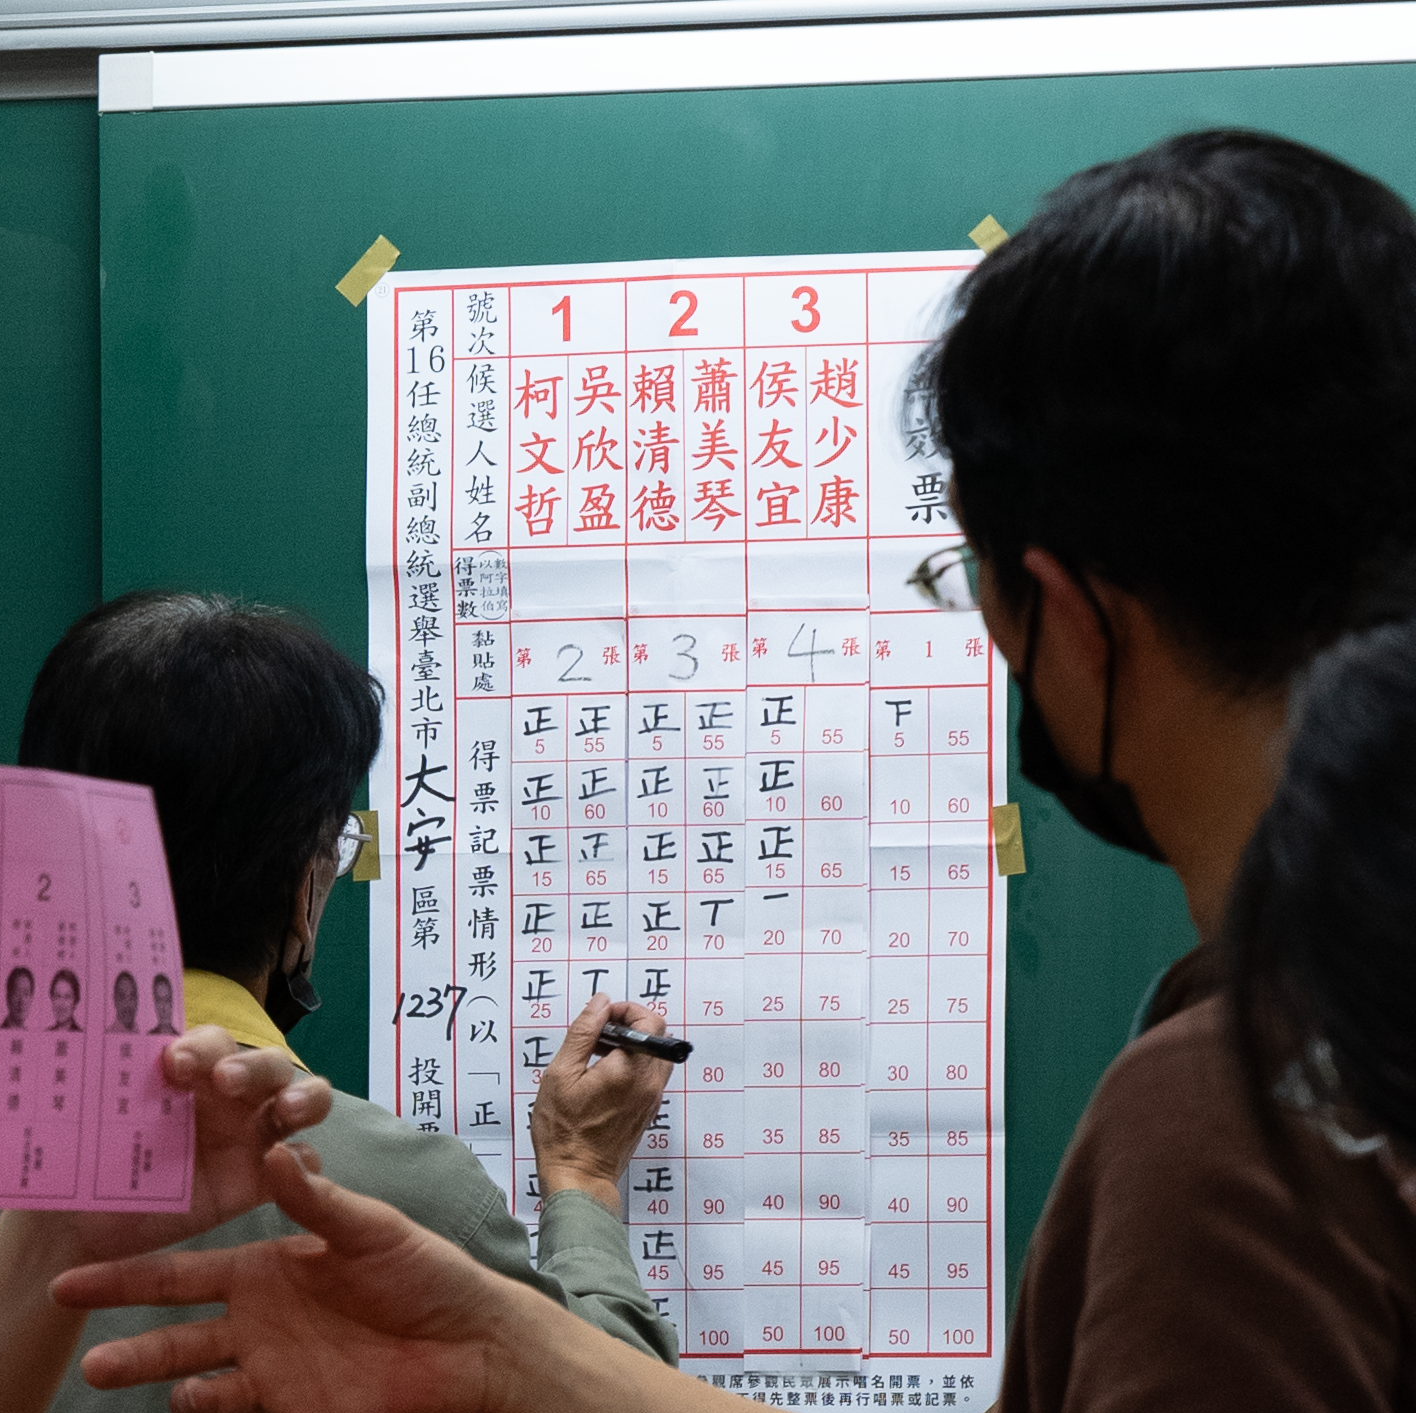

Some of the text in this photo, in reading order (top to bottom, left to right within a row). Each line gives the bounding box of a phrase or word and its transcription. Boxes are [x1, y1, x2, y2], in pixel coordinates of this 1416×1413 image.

[668, 290, 699, 337] 2
[791, 286, 821, 333] 3
[466, 292, 497, 355] 號次
[551, 295, 571, 341] 1
[571, 365, 623, 532] 吳欣盈
[630, 364, 680, 532] 賴清德
[691, 357, 742, 532] 蕭美琴
[750, 361, 803, 528] 侯友宜
[810, 357, 863, 528] 趙少康
[465, 364, 497, 544] 候選人姓名
[514, 368, 564, 537] 柯文哲
[455, 557, 478, 619] 得票數
[634, 634, 740, 680] 第 3 張
[753, 623, 860, 686] 第 4 張
[876, 638, 983, 660] 第 1 張
[471, 630, 496, 692] 黏貼處
[517, 644, 620, 682] 第 2 張
[638, 704, 681, 734] 正
[697, 702, 733, 730] 正
[761, 696, 796, 726] 正
[523, 707, 557, 736] 正
[575, 706, 610, 739] 正
[653, 736, 662, 751] 5
[703, 735, 724, 750] 55
[771, 730, 781, 745] 5
[822, 729, 843, 744] 55
[895, 732, 904, 747] 5
[948, 730, 969, 746] 55
[535, 739, 545, 754] 5
[584, 737, 605, 753] 55
[578, 768, 616, 800] 正
[637, 766, 672, 798] 正
[703, 768, 731, 800] 正
[759, 760, 794, 792] 正
[522, 774, 562, 808] 正
[585, 804, 605, 819] 60
[648, 802, 668, 818] 10
[703, 801, 724, 817] 60
[767, 796, 786, 812] 10
[821, 796, 842, 811] 60
[891, 799, 910, 814] 10
[948, 798, 969, 813] 60
[532, 805, 551, 820] 10
[524, 835, 556, 865] 正
[581, 833, 608, 860] 正
[644, 832, 676, 861] 正
[697, 831, 733, 863] 正
[758, 826, 793, 860] 正
[533, 871, 552, 886] 15
[586, 870, 606, 886] 65
[649, 869, 668, 884] 15
[703, 868, 724, 884] 65
[766, 863, 785, 878] 15
[821, 863, 842, 878] 65
[891, 865, 910, 881] 15
[948, 864, 969, 880] 65
[37, 873, 51, 902] 2
[129, 881, 141, 909] 3
[522, 903, 554, 934] 正
[581, 902, 612, 929] 正
[643, 901, 680, 932] 正
[532, 937, 552, 952] 20
[587, 936, 607, 951] 70
[647, 935, 668, 950] 20
[703, 934, 724, 950] 70
[764, 930, 784, 945] 20
[821, 929, 841, 944] 70
[889, 932, 910, 948] 20
[948, 931, 969, 946] 70
[522, 970, 555, 1001] 正
[640, 969, 671, 1001] 正
[530, 1003, 551, 1018] 25
[703, 1001, 723, 1016] 75
[763, 996, 784, 1011] 25
[820, 996, 840, 1011] 75
[888, 999, 909, 1014] 25
[947, 998, 968, 1013] 75
[391, 983, 468, 1041] 1237
[703, 1067, 724, 1082] 80
[763, 1062, 784, 1078] 30
[819, 1062, 840, 1077] 80
[888, 1065, 908, 1081] 30
[946, 1065, 967, 1080] 80
[647, 1134, 668, 1149] 35
[703, 1133, 724, 1148] 85
[763, 1129, 784, 1144] 35
[819, 1129, 840, 1144] 85
[889, 1131, 909, 1146] 35
[947, 1130, 968, 1146] 85
[633, 1167, 673, 1193] 正
[647, 1199, 668, 1214] 40
[703, 1199, 724, 1214] 90
[763, 1195, 784, 1210] 40
[819, 1195, 840, 1210] 90
[888, 1198, 909, 1213] 40
[947, 1197, 968, 1212] 90
[647, 1265, 669, 1280] 45
[703, 1265, 724, 1280] 95
[762, 1261, 783, 1276] 45
[819, 1260, 839, 1275] 95
[888, 1264, 910, 1279] 45
[947, 1263, 968, 1278] 95
[700, 1330, 729, 1346] 100
[763, 1326, 783, 1341] 50
[815, 1326, 845, 1341] 100
[889, 1329, 910, 1345] 50
[943, 1329, 974, 1344] 100
